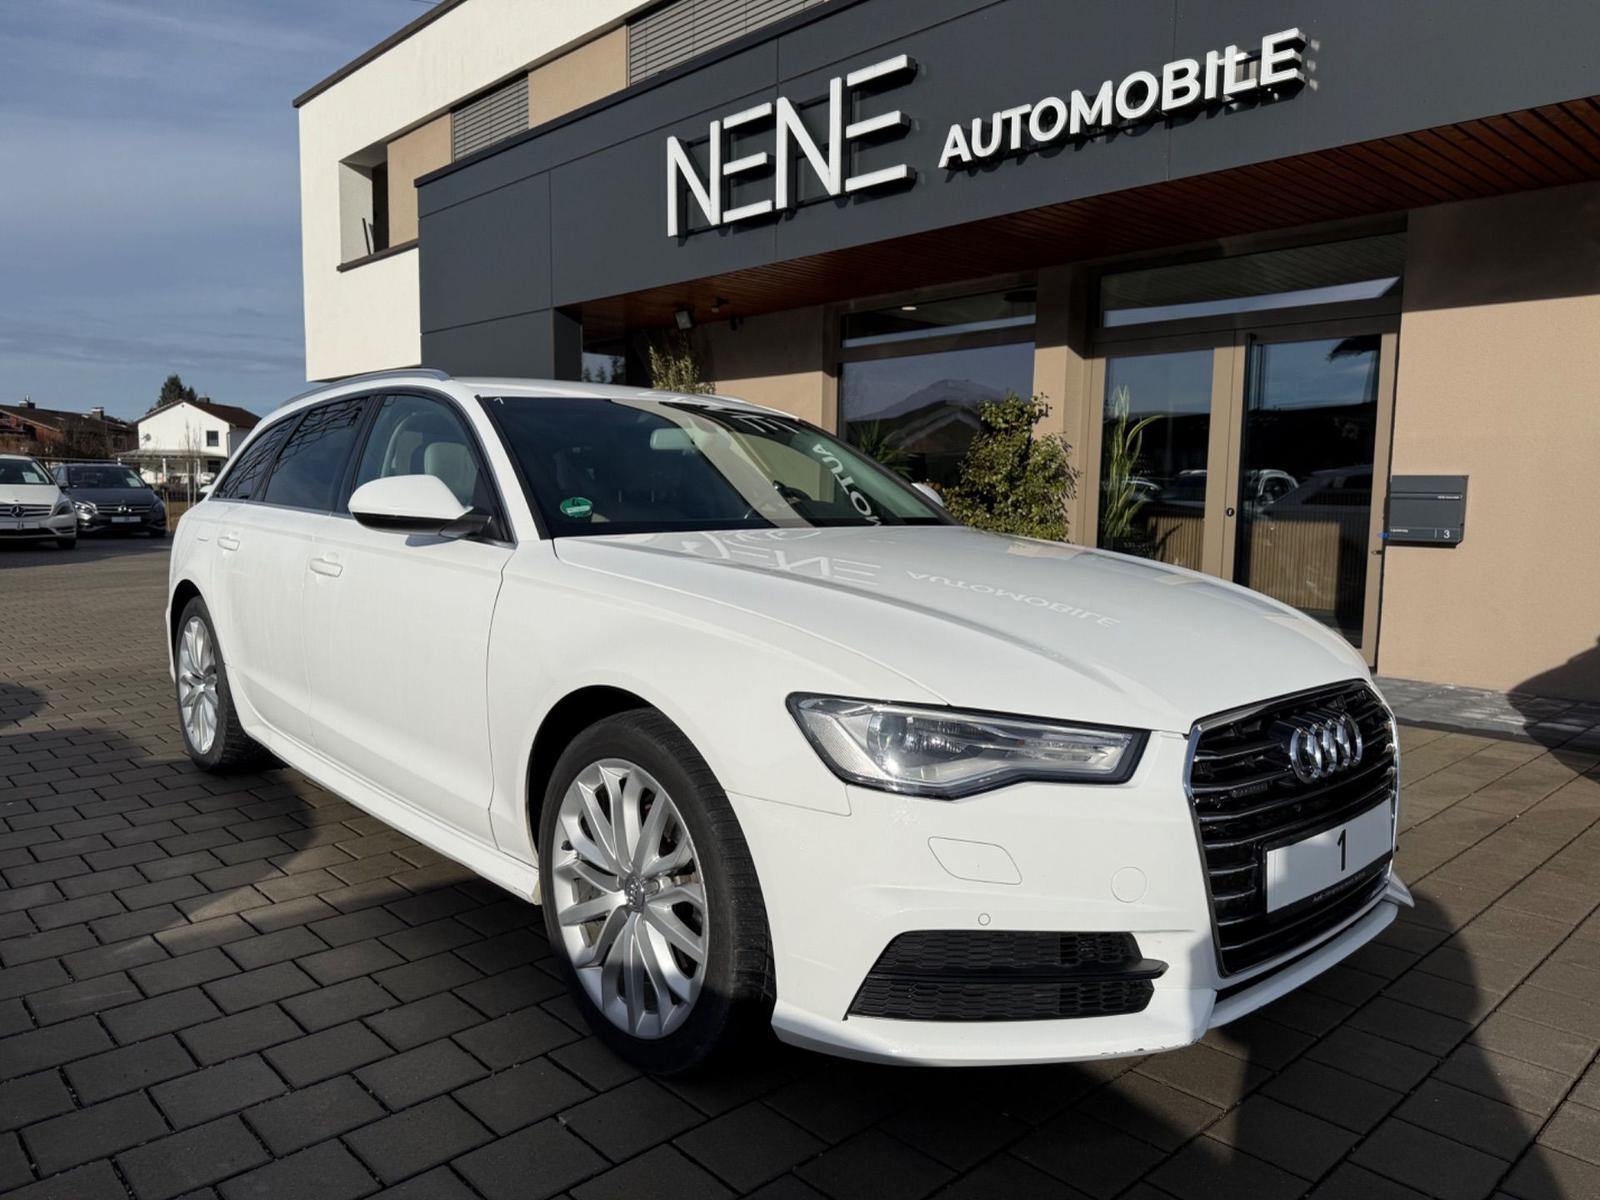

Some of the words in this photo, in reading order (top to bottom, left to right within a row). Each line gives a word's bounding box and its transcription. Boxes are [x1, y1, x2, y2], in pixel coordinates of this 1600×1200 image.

[667, 54, 909, 237] NENE
[938, 28, 1303, 168] AUTOMOBILE
[1443, 529, 1450, 539] 3
[1338, 829, 1347, 872] 1
